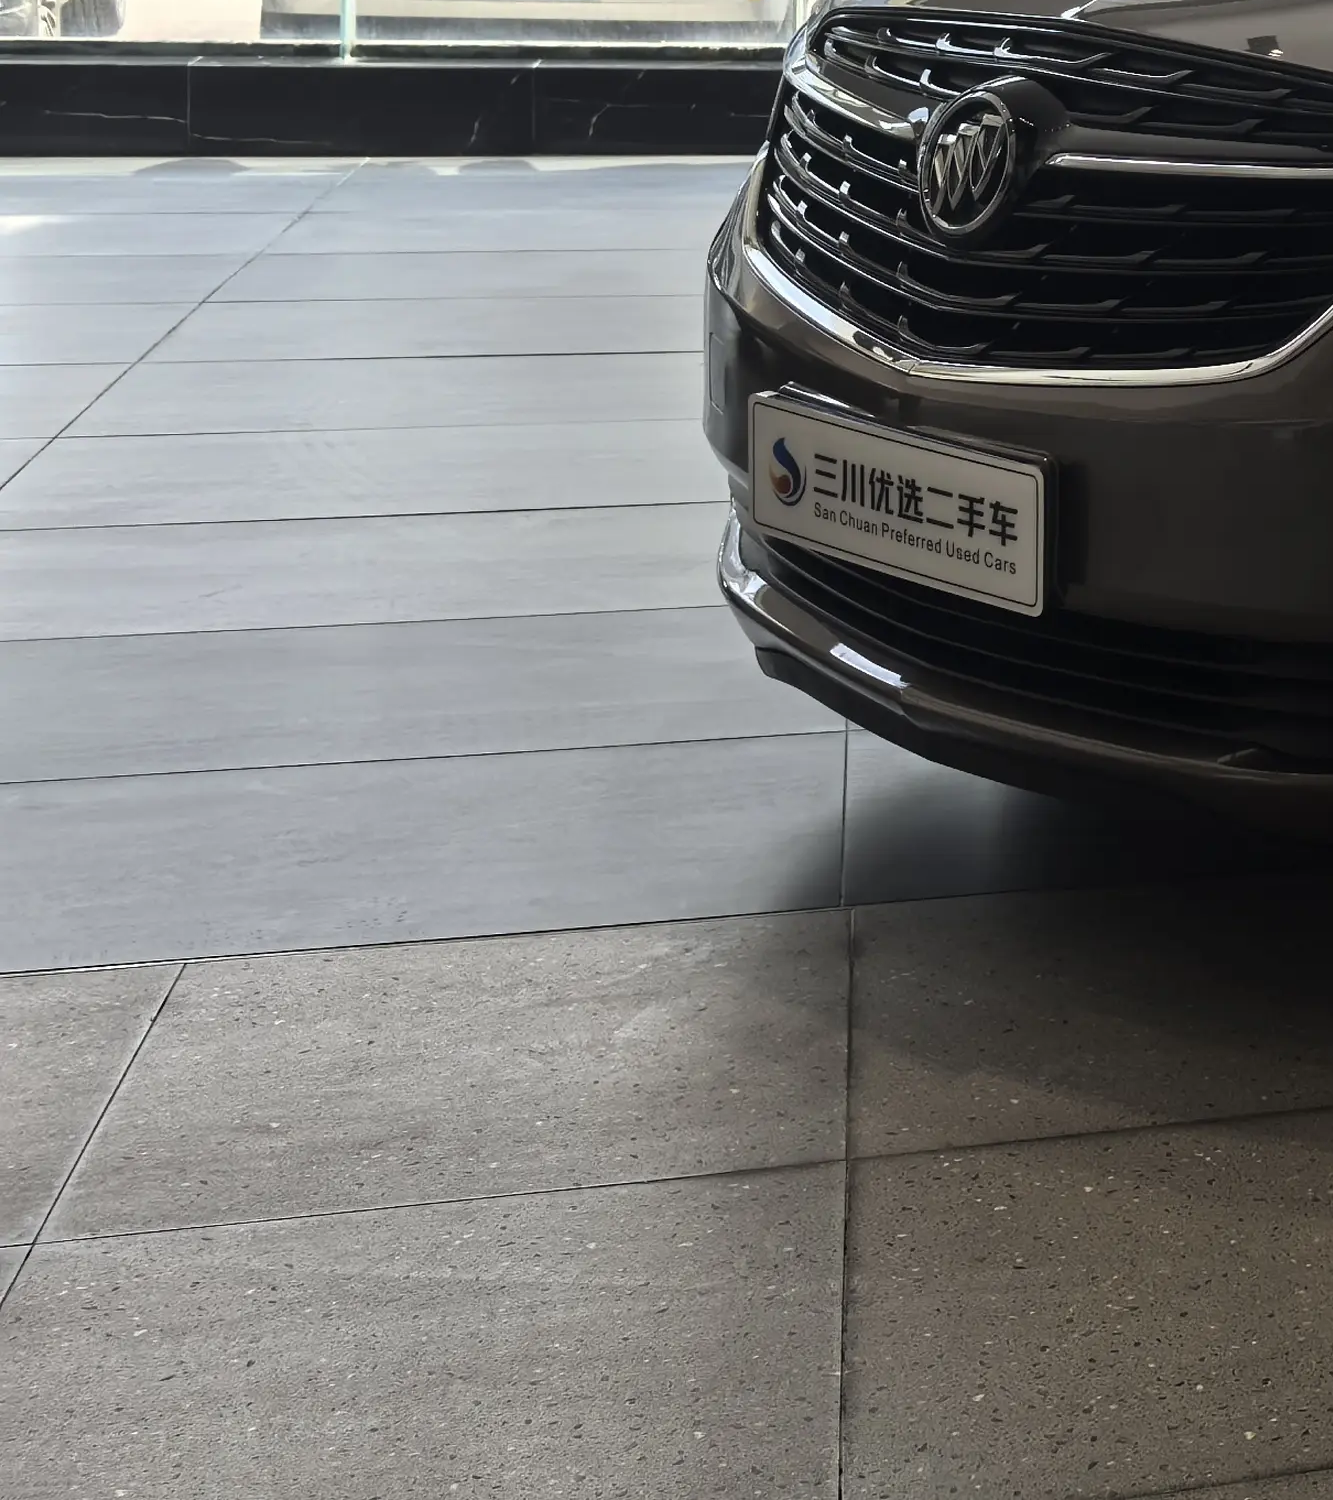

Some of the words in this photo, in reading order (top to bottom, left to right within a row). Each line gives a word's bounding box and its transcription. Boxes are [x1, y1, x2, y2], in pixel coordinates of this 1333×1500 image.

[813, 453, 1018, 547] 三川优选二手车
[814, 501, 837, 524] San
[839, 509, 878, 537] Chuan
[881, 521, 942, 555] Preferred
[946, 540, 980, 565] Used
[984, 551, 1017, 575] Cars
